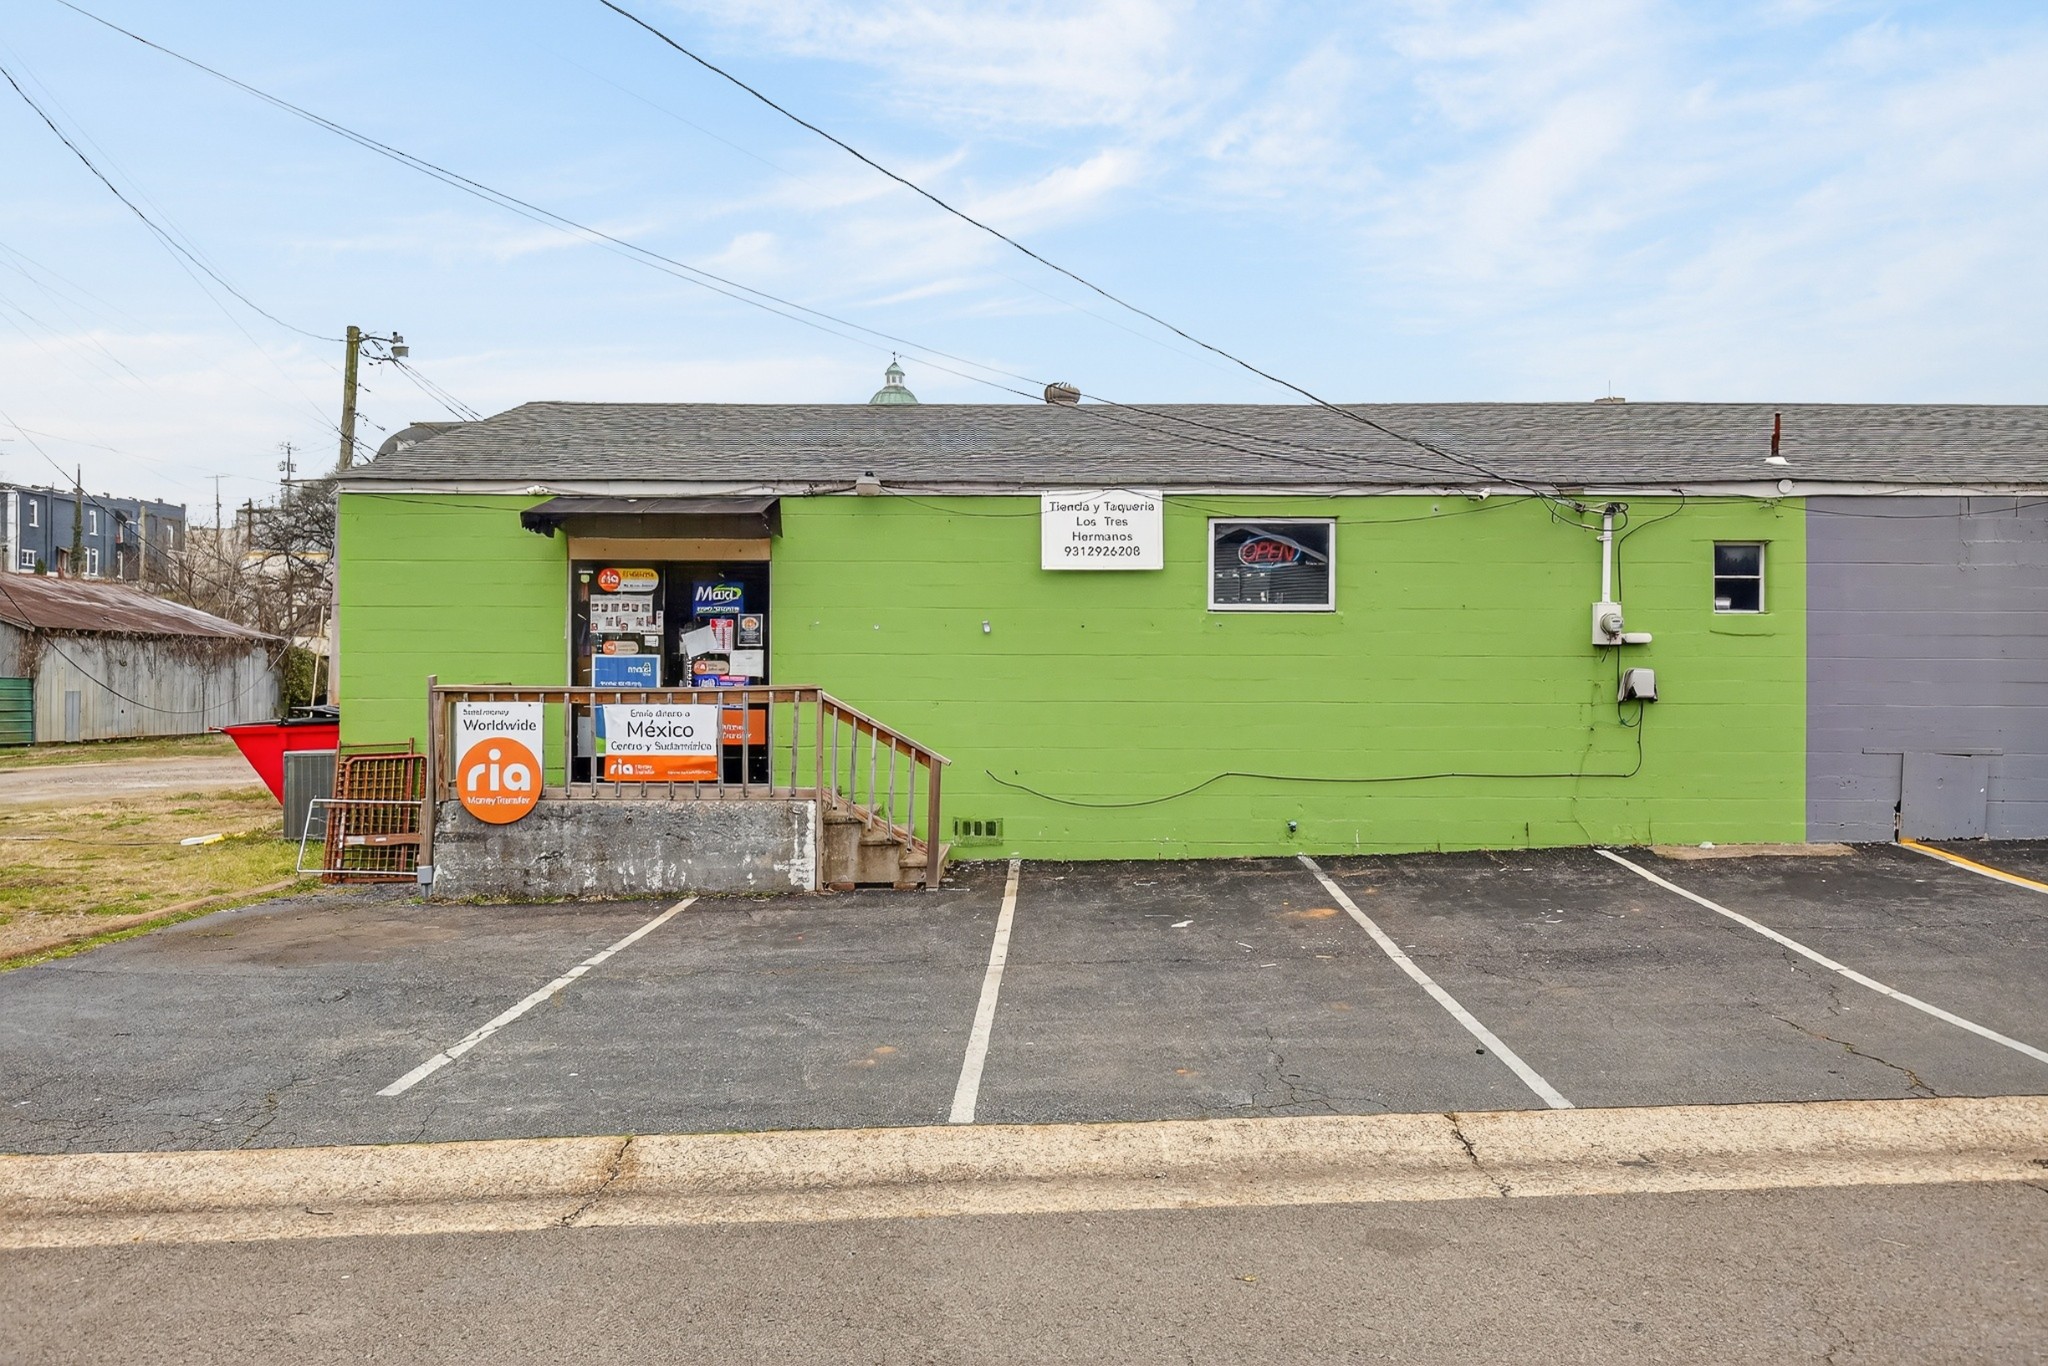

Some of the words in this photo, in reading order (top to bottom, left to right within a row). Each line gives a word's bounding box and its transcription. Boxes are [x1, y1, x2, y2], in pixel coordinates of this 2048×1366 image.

[1049, 501, 1090, 512] Tienda
[1093, 504, 1100, 514] y
[1076, 516, 1097, 527] Los
[1104, 516, 1129, 527] Tres
[1072, 531, 1133, 542] Hermanos
[1064, 546, 1141, 557] 9312926208
[1241, 541, 1296, 562] OPEN
[463, 719, 537, 731] Worldwide
[627, 719, 694, 738] México
[611, 741, 642, 751] Centro
[643, 743, 652, 752] y
[467, 748, 531, 791] ria
[610, 758, 634, 775] ria
[468, 796, 496, 806] Money
